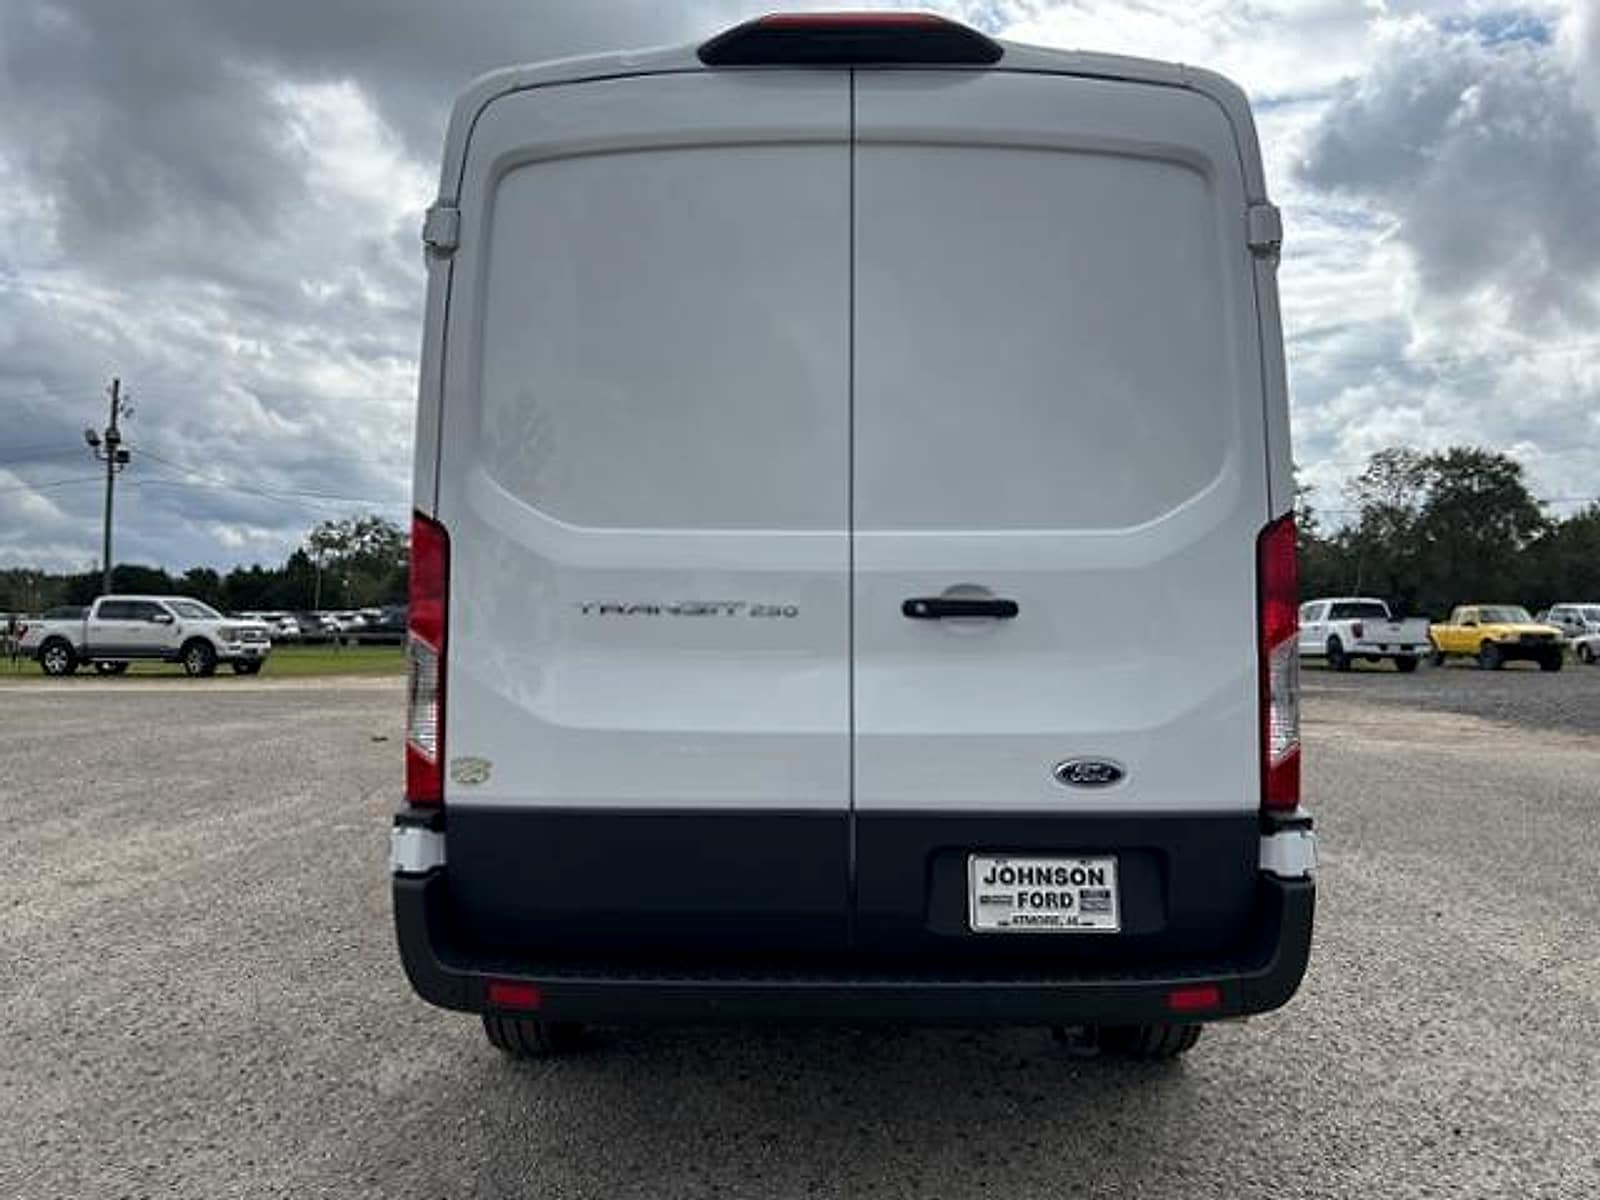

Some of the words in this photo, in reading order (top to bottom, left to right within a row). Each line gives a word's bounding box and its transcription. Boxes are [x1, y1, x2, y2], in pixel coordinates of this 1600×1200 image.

[578, 600, 746, 617] TRANSIT
[983, 867, 1104, 886] JOHNSON
[1017, 892, 1075, 909] FORD
